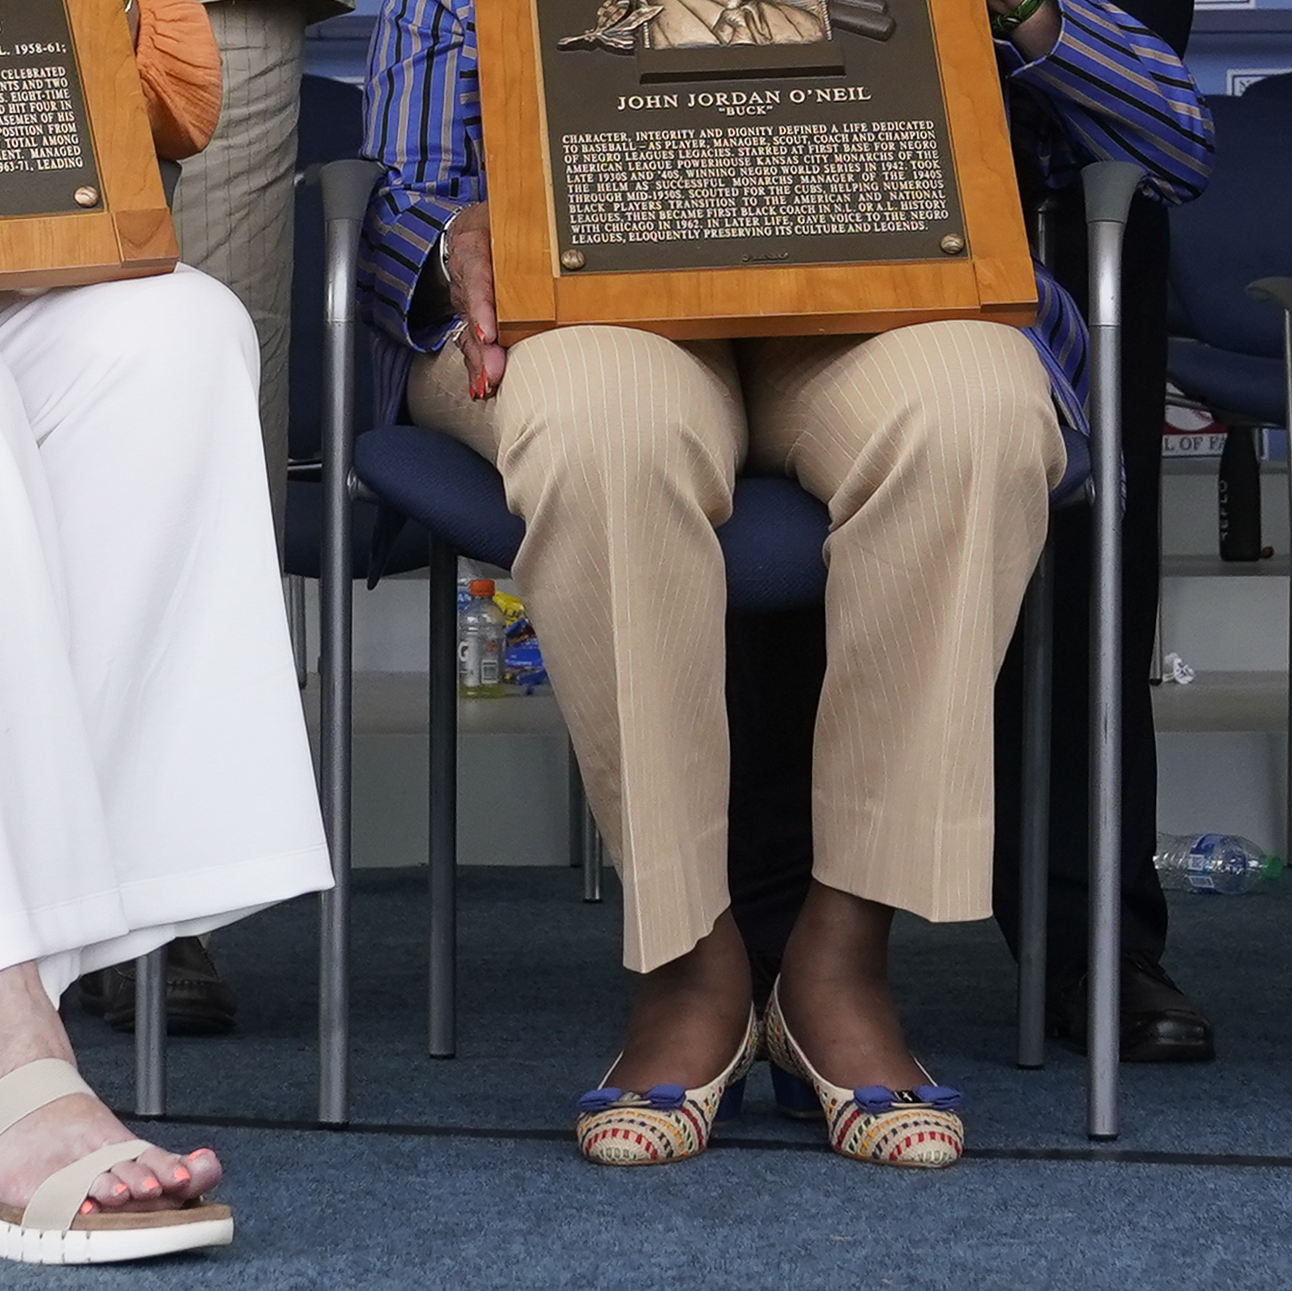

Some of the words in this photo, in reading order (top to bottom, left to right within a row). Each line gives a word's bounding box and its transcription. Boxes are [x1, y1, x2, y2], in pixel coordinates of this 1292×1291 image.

[617, 94, 677, 109] JOHN
[687, 90, 779, 106] JORDAN
[1179, 436, 1203, 451] OF
